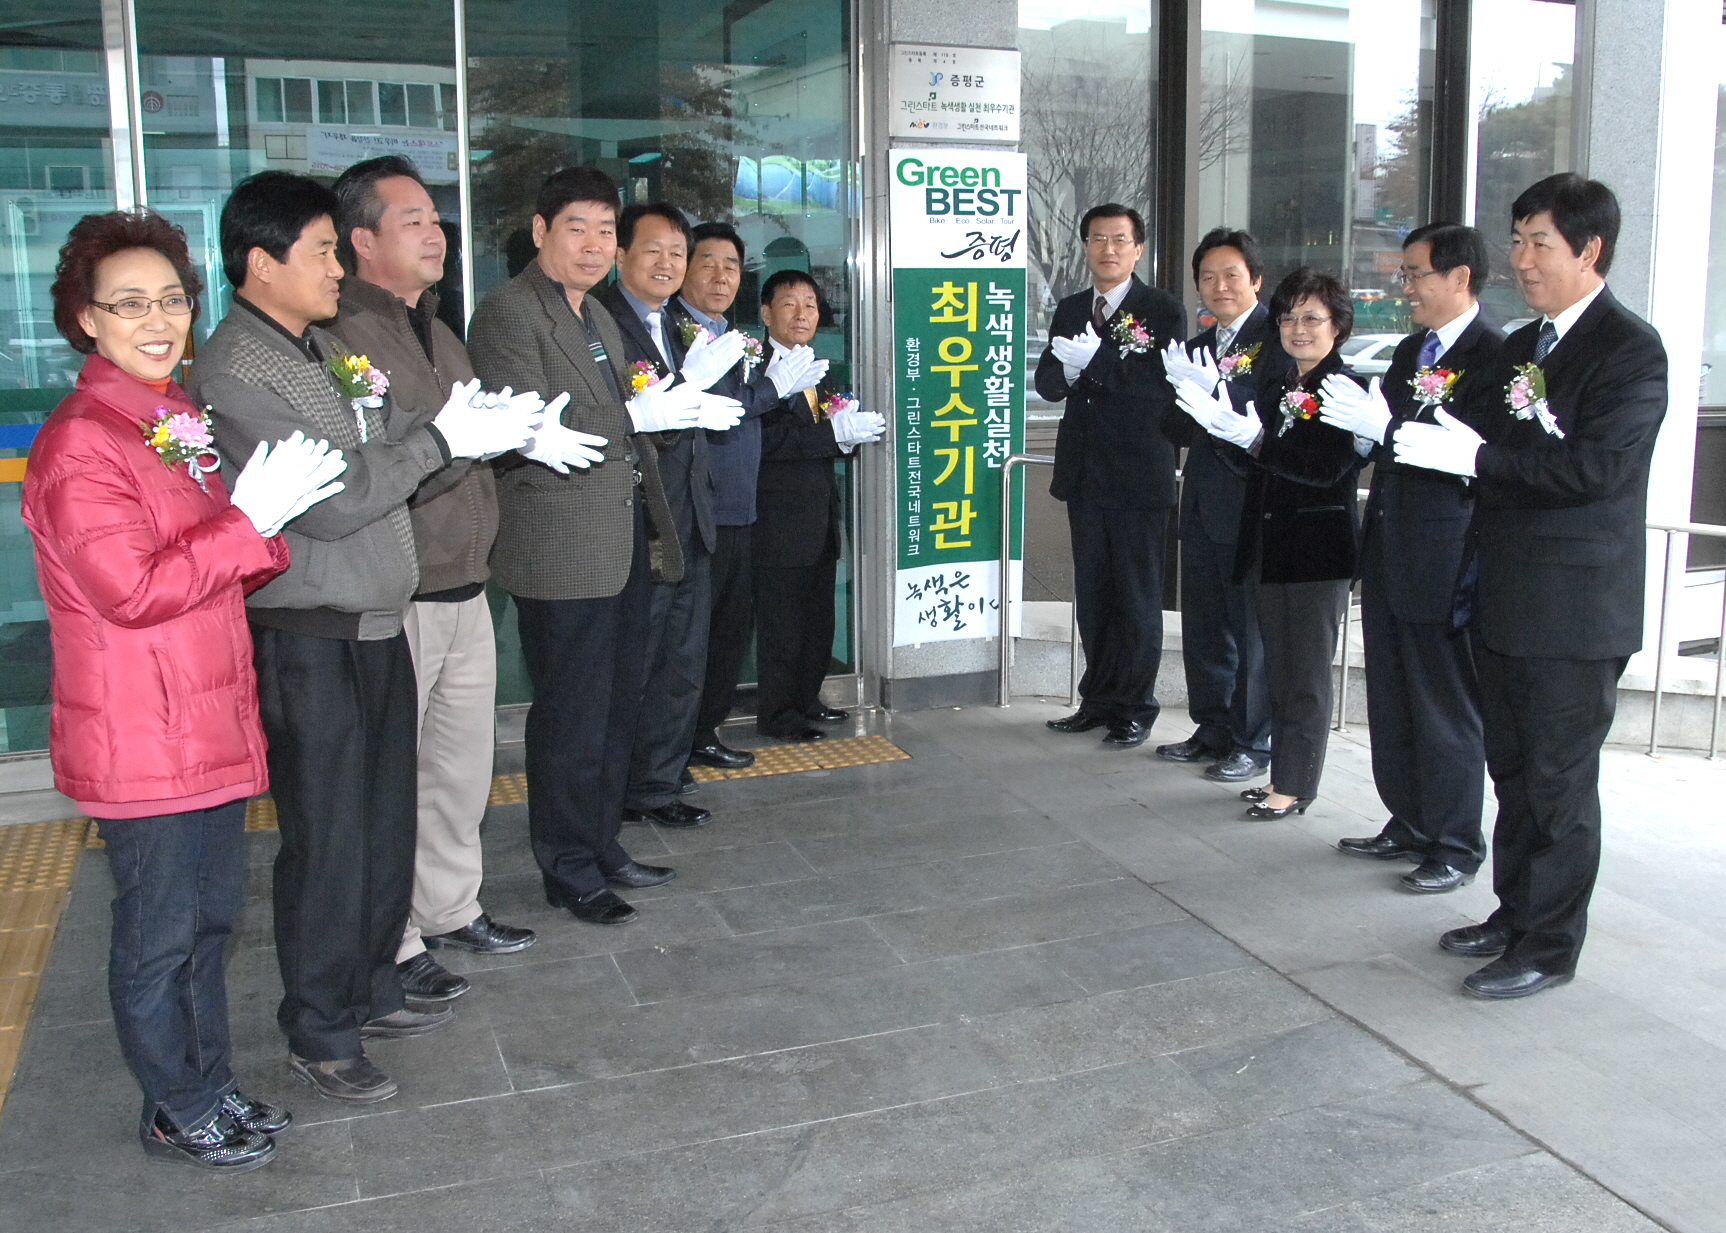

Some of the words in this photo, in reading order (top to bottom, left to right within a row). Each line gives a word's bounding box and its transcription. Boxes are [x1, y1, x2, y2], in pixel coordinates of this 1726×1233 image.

[950, 75, 985, 88] 증평군
[900, 101, 938, 114] 그린스타트
[940, 101, 967, 112] 녹색생활
[968, 102, 982, 113] 실천
[983, 103, 1015, 115] 최우수기관
[896, 157, 1001, 188] Green
[925, 188, 1022, 216] BEST
[941, 229, 1021, 262] 증평
[982, 281, 1015, 469] 녹색생활실천
[929, 280, 980, 550] 최우수기관
[905, 570, 971, 601] 녹색은
